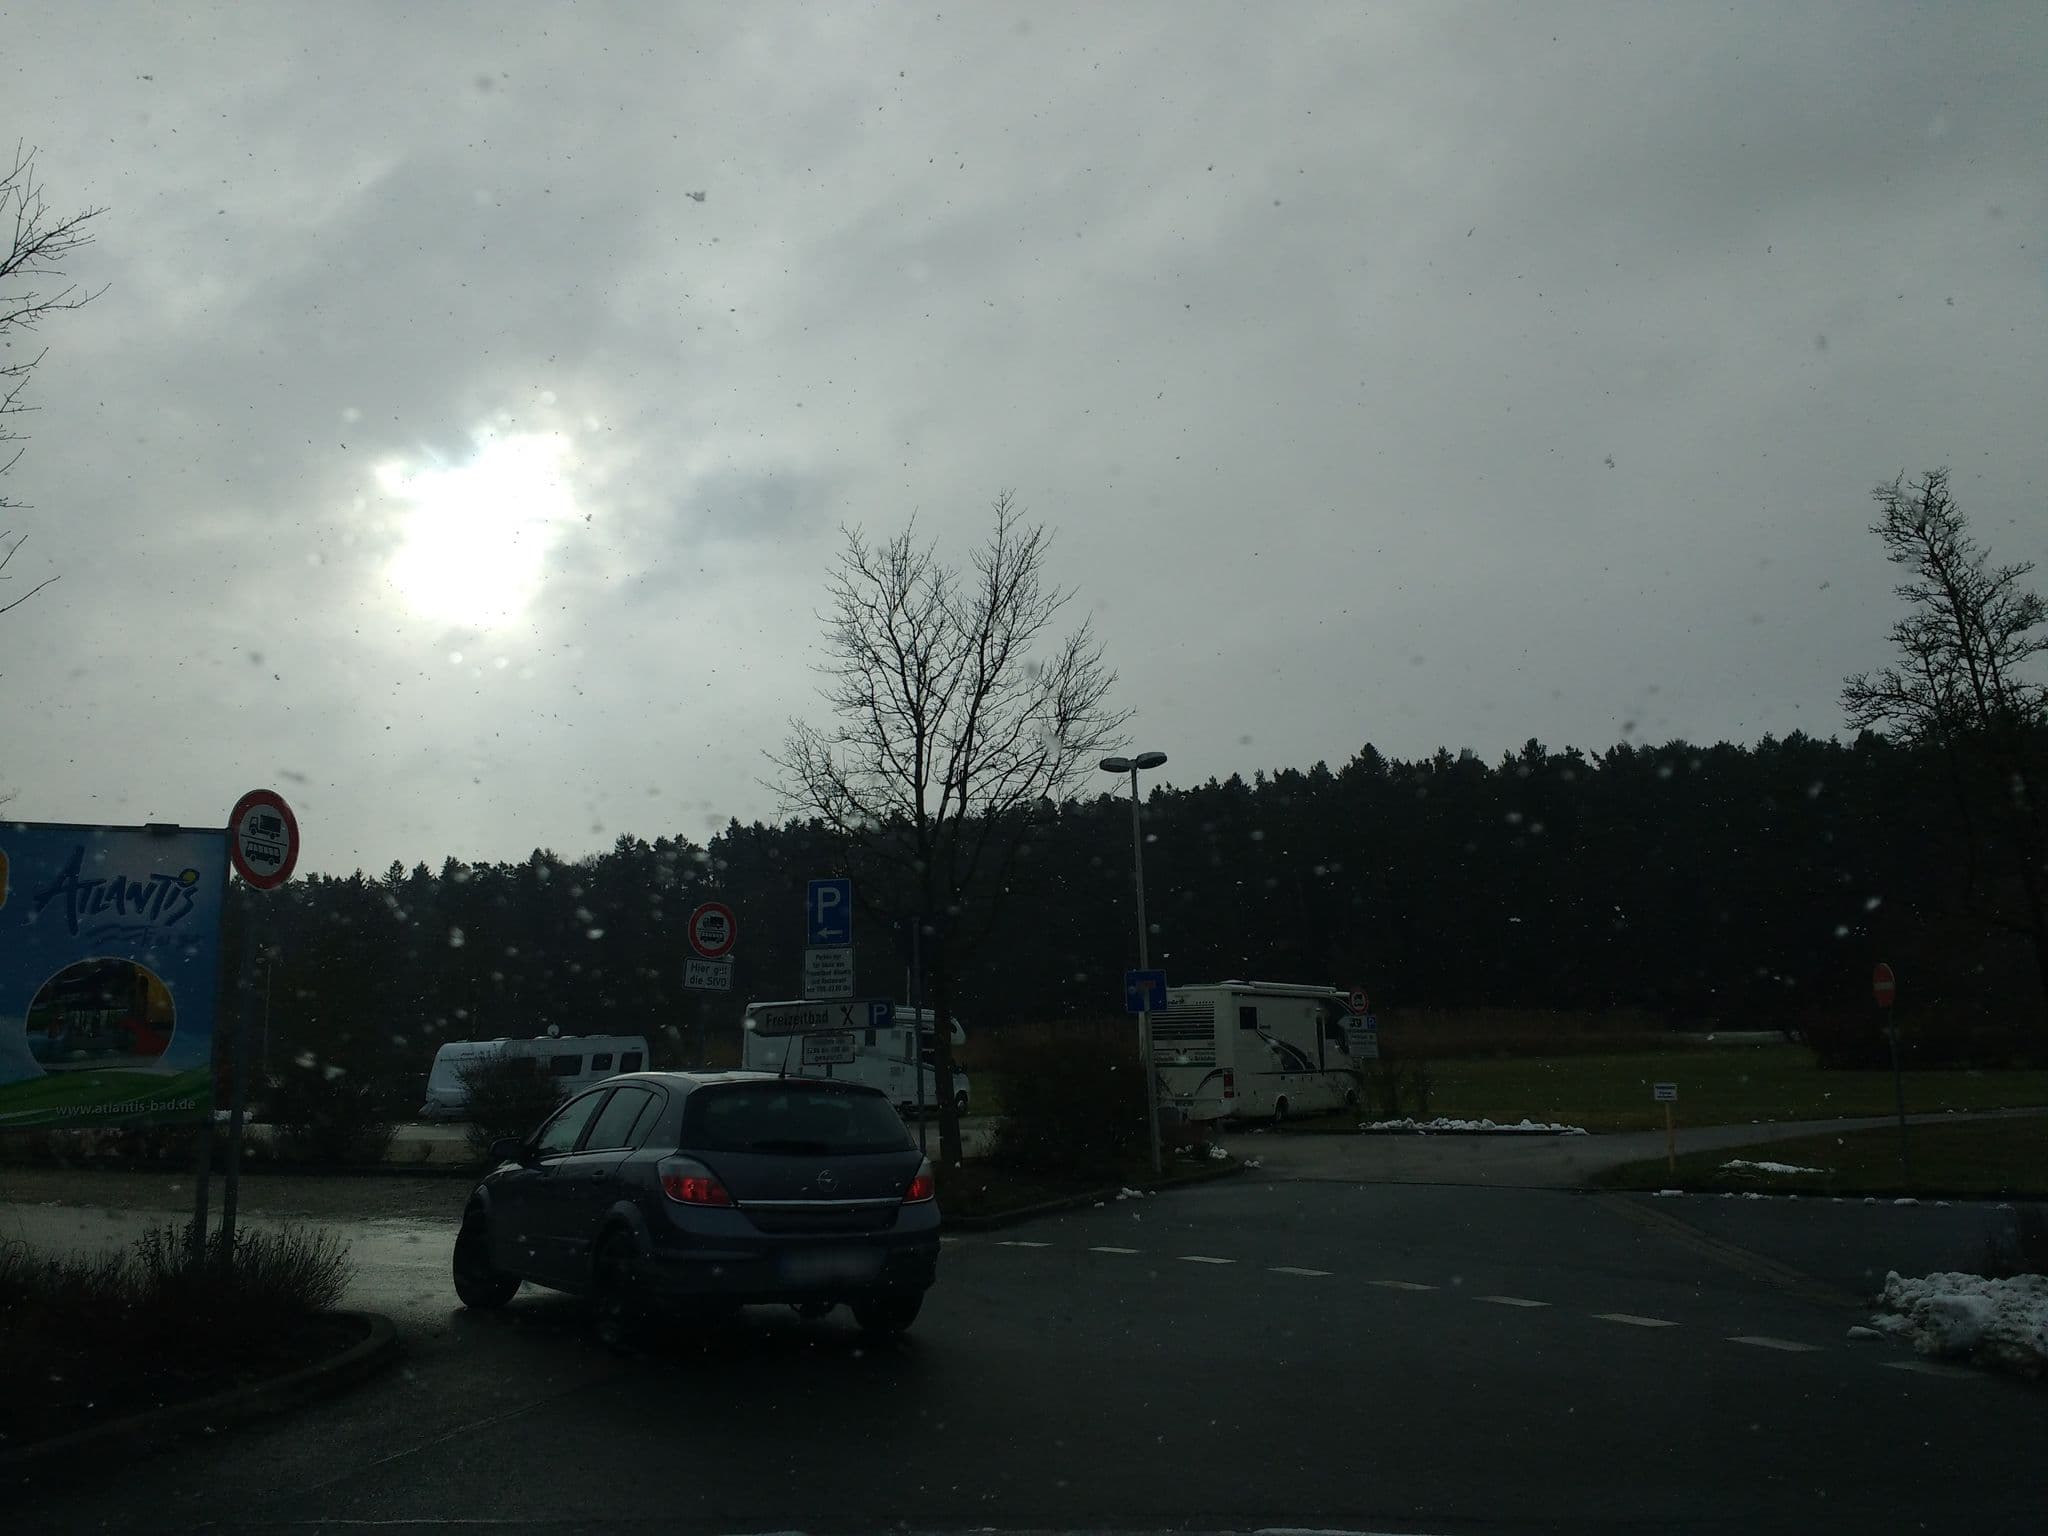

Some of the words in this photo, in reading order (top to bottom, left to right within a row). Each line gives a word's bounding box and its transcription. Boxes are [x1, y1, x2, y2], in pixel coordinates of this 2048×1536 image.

[817, 887, 841, 924] P
[766, 1008, 829, 1025] Freizeitbad
[873, 1003, 889, 1024] P
[55, 1098, 196, 1116] www.atlantis-bad.de
